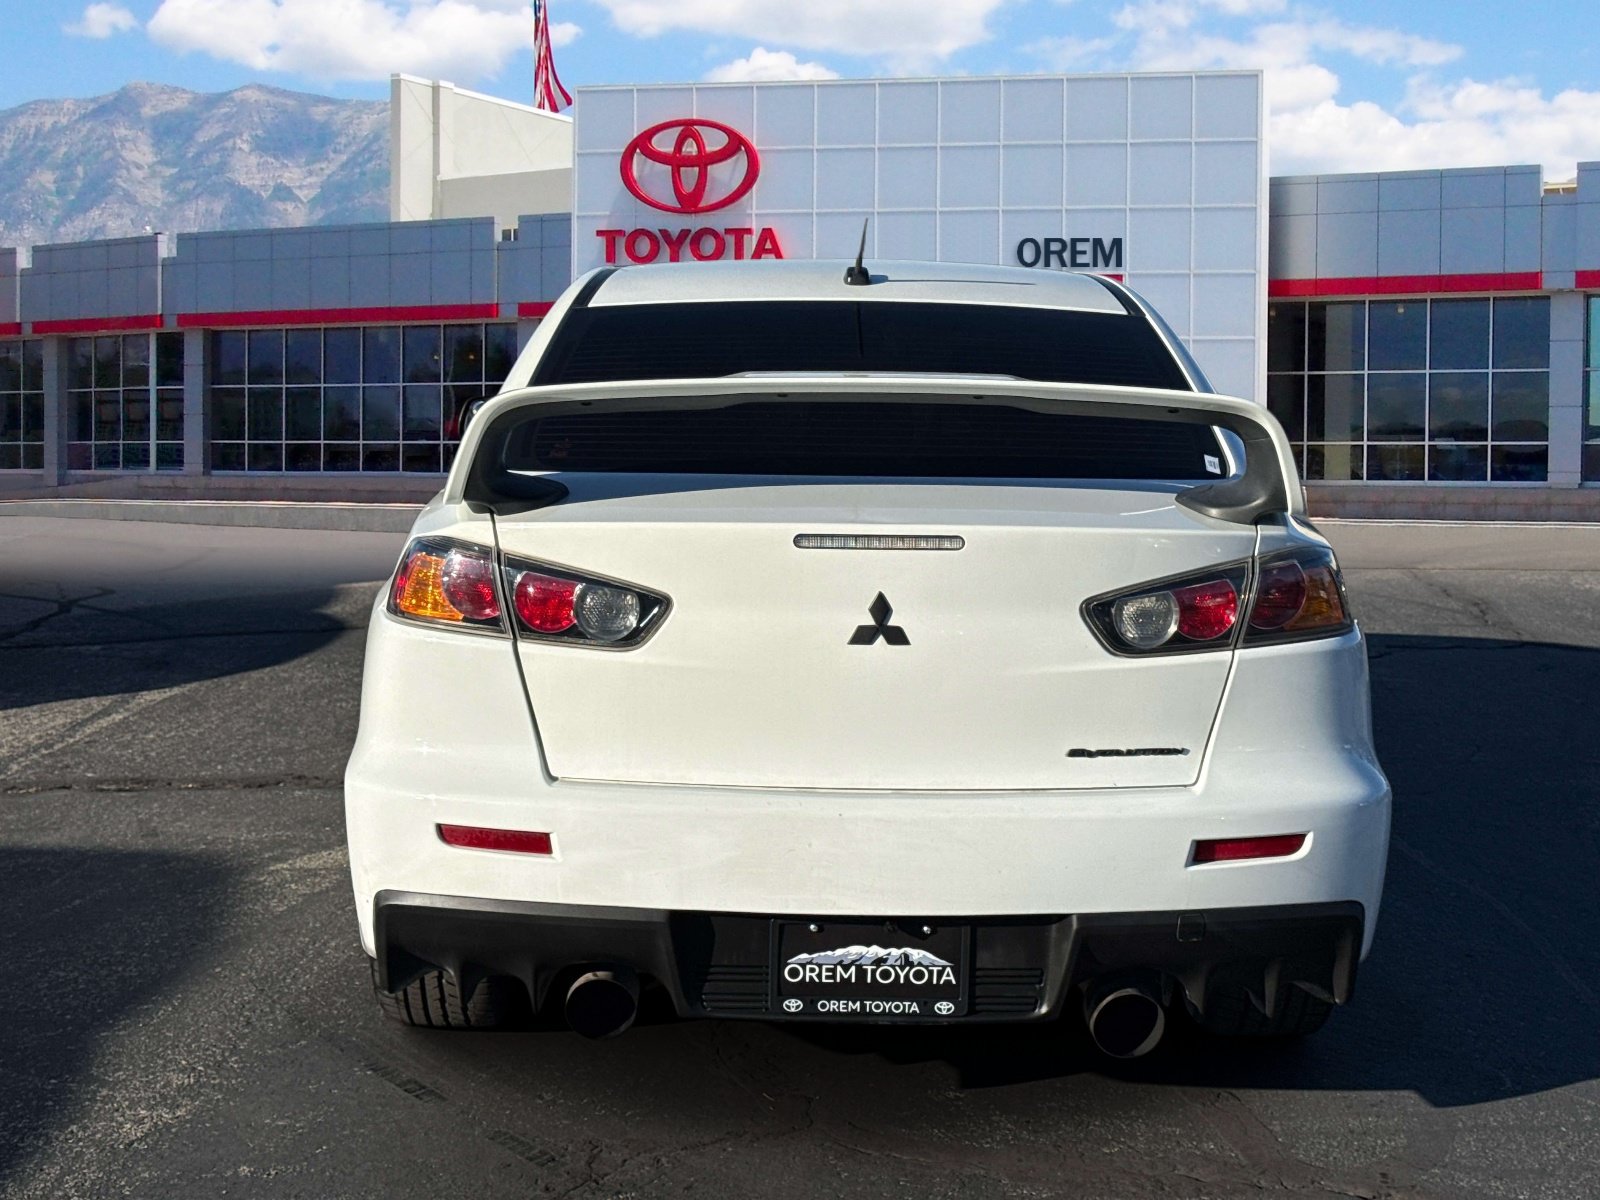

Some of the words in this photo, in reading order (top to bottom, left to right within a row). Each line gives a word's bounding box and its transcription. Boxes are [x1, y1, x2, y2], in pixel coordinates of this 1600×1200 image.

[596, 228, 784, 265] TOYOTA
[1016, 237, 1123, 268] OREM
[784, 963, 856, 983] OREM
[862, 965, 957, 985] TOYOTA
[817, 1000, 861, 1012] OREM
[863, 1001, 920, 1014] TOYOTA
